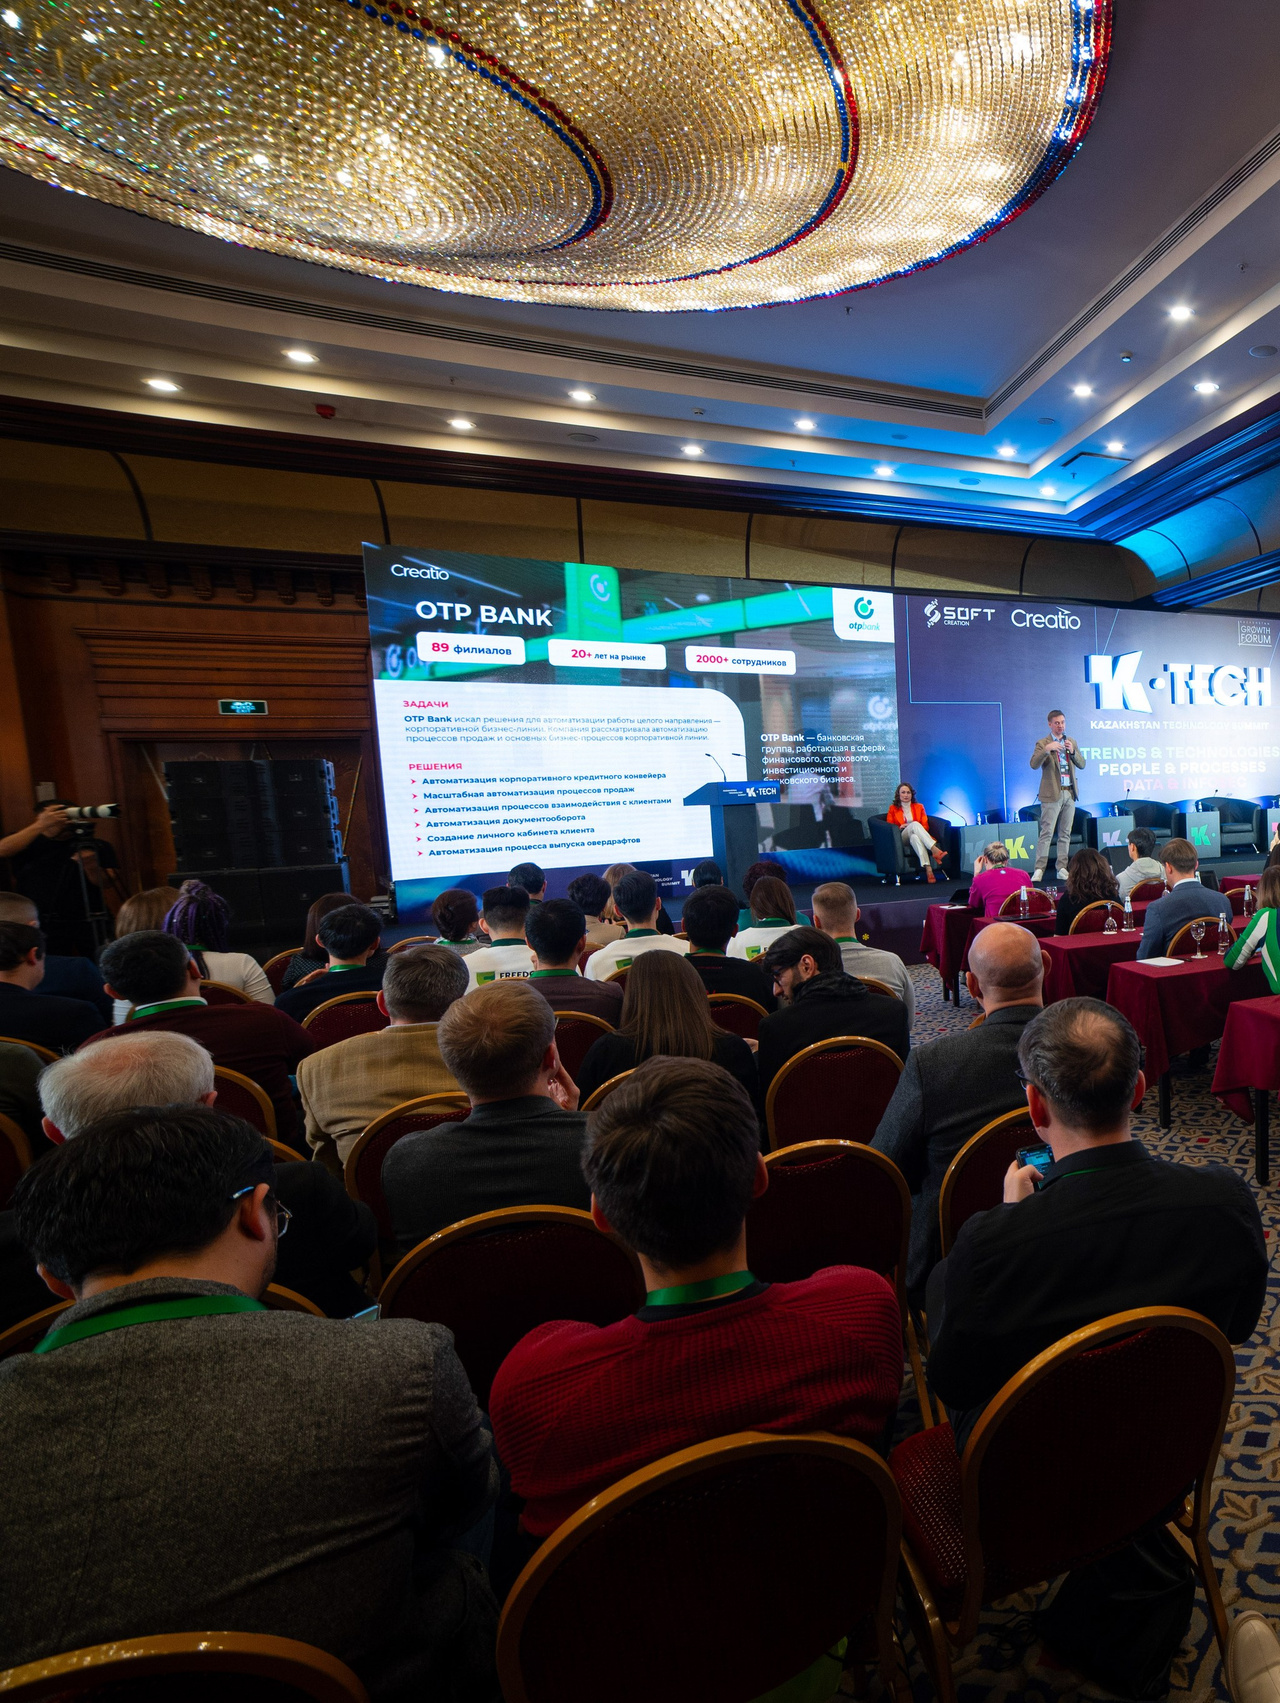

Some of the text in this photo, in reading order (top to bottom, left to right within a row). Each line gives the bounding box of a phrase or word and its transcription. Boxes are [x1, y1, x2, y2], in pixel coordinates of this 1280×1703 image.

[391, 564, 449, 580] Creatio
[416, 601, 553, 627] OTP BANK
[943, 606, 995, 621] SOFT
[1011, 606, 1081, 630] Creatio
[431, 643, 512, 656] 89 филиалов
[571, 649, 592, 658] 20+
[621, 654, 646, 662] рынке
[696, 655, 787, 667] 2000+ сотрудников
[403, 700, 449, 708] ЗАДАЧИ
[428, 715, 452, 723] Bank
[483, 717, 524, 725] решения
[543, 717, 605, 725] автоматизации
[607, 717, 636, 725] работы
[1090, 720, 1160, 730] KAZAKHSTAN
[405, 725, 479, 734] корпоративной
[591, 726, 650, 734] рассматривала
[406, 735, 458, 743] процессов
[460, 735, 496, 743] продаж
[549, 734, 624, 742] бизнес-процессов
[625, 733, 683, 742] корпоративной
[760, 733, 864, 742] OTP Bank банковская
[761, 745, 794, 754] группа,
[796, 744, 849, 753] работающая
[857, 744, 886, 753] сферах
[1080, 746, 1280, 760] TRENDS & TECHNOLOGIES
[762, 755, 871, 764] финансового, страхового,
[762, 766, 840, 775] инвестиционного
[1099, 761, 1266, 776] PEOPLE & PROCESSES
[422, 772, 666, 785] Автоматизация корпоративного кредитного конвейера
[820, 775, 856, 784] бизнеса.
[1123, 778, 1162, 791] DATA
[423, 791, 484, 799] Масштабная
[486, 789, 554, 798] автоматизация
[557, 787, 602, 795] процессов
[425, 805, 499, 814] Автоматизация
[501, 803, 549, 811] процессов
[551, 800, 620, 809] взаимодействия
[426, 814, 586, 828] Автоматизация документооборота
[427, 827, 595, 842] Создание личного кабинета клиента
[428, 837, 641, 856] Автоматизация процесса выпуска овердрафтов
